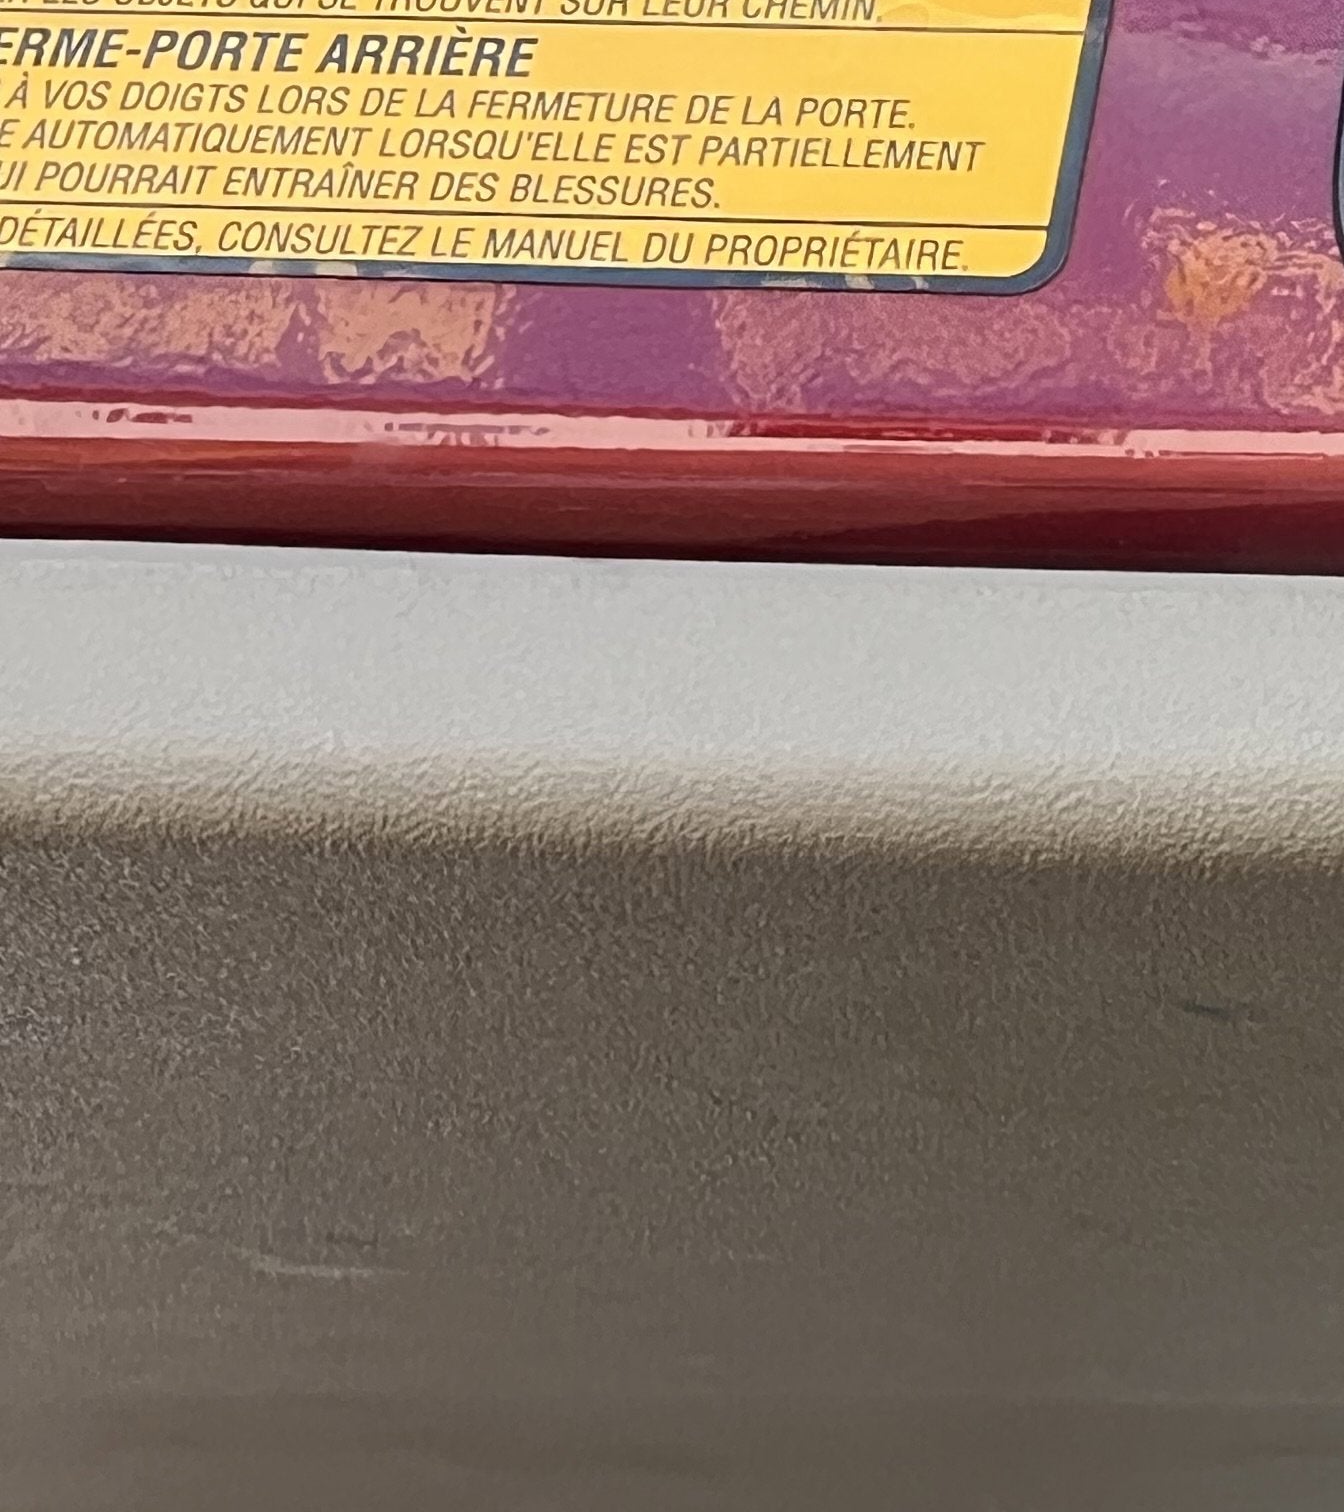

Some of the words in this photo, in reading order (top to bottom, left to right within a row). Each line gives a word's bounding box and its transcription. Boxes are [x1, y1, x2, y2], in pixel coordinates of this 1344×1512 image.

[315, 25, 539, 77] ARRIÈRE
[4, 71, 30, 109] À
[44, 80, 112, 111] VOS
[119, 81, 248, 113] DOIGTS
[257, 85, 350, 115] LORS
[359, 87, 407, 117] DE
[414, 89, 455, 118] LA
[467, 90, 678, 123] FERMETURE
[685, 95, 736, 125] DE
[741, 96, 782, 126] LA
[795, 97, 916, 130] PORTE.
[22, 119, 373, 156] AUTOMATIQUEMENT
[378, 127, 617, 163] LORSQU'ELLE
[624, 134, 692, 166] EST
[699, 136, 987, 172] PARTIELLEMENT
[34, 160, 218, 195] POURRAIT
[222, 161, 419, 200] ENTRAÎNER
[429, 171, 500, 203] DES
[509, 173, 721, 209] BLESSURES.
[0, 209, 203, 253] DÉTAILLÉES,
[217, 220, 424, 257] CONSULTEZ
[431, 226, 476, 258] LE
[482, 228, 629, 262] MANUEL
[643, 231, 694, 264] DU
[704, 230, 969, 272] PROPRIÉTAIRE.
